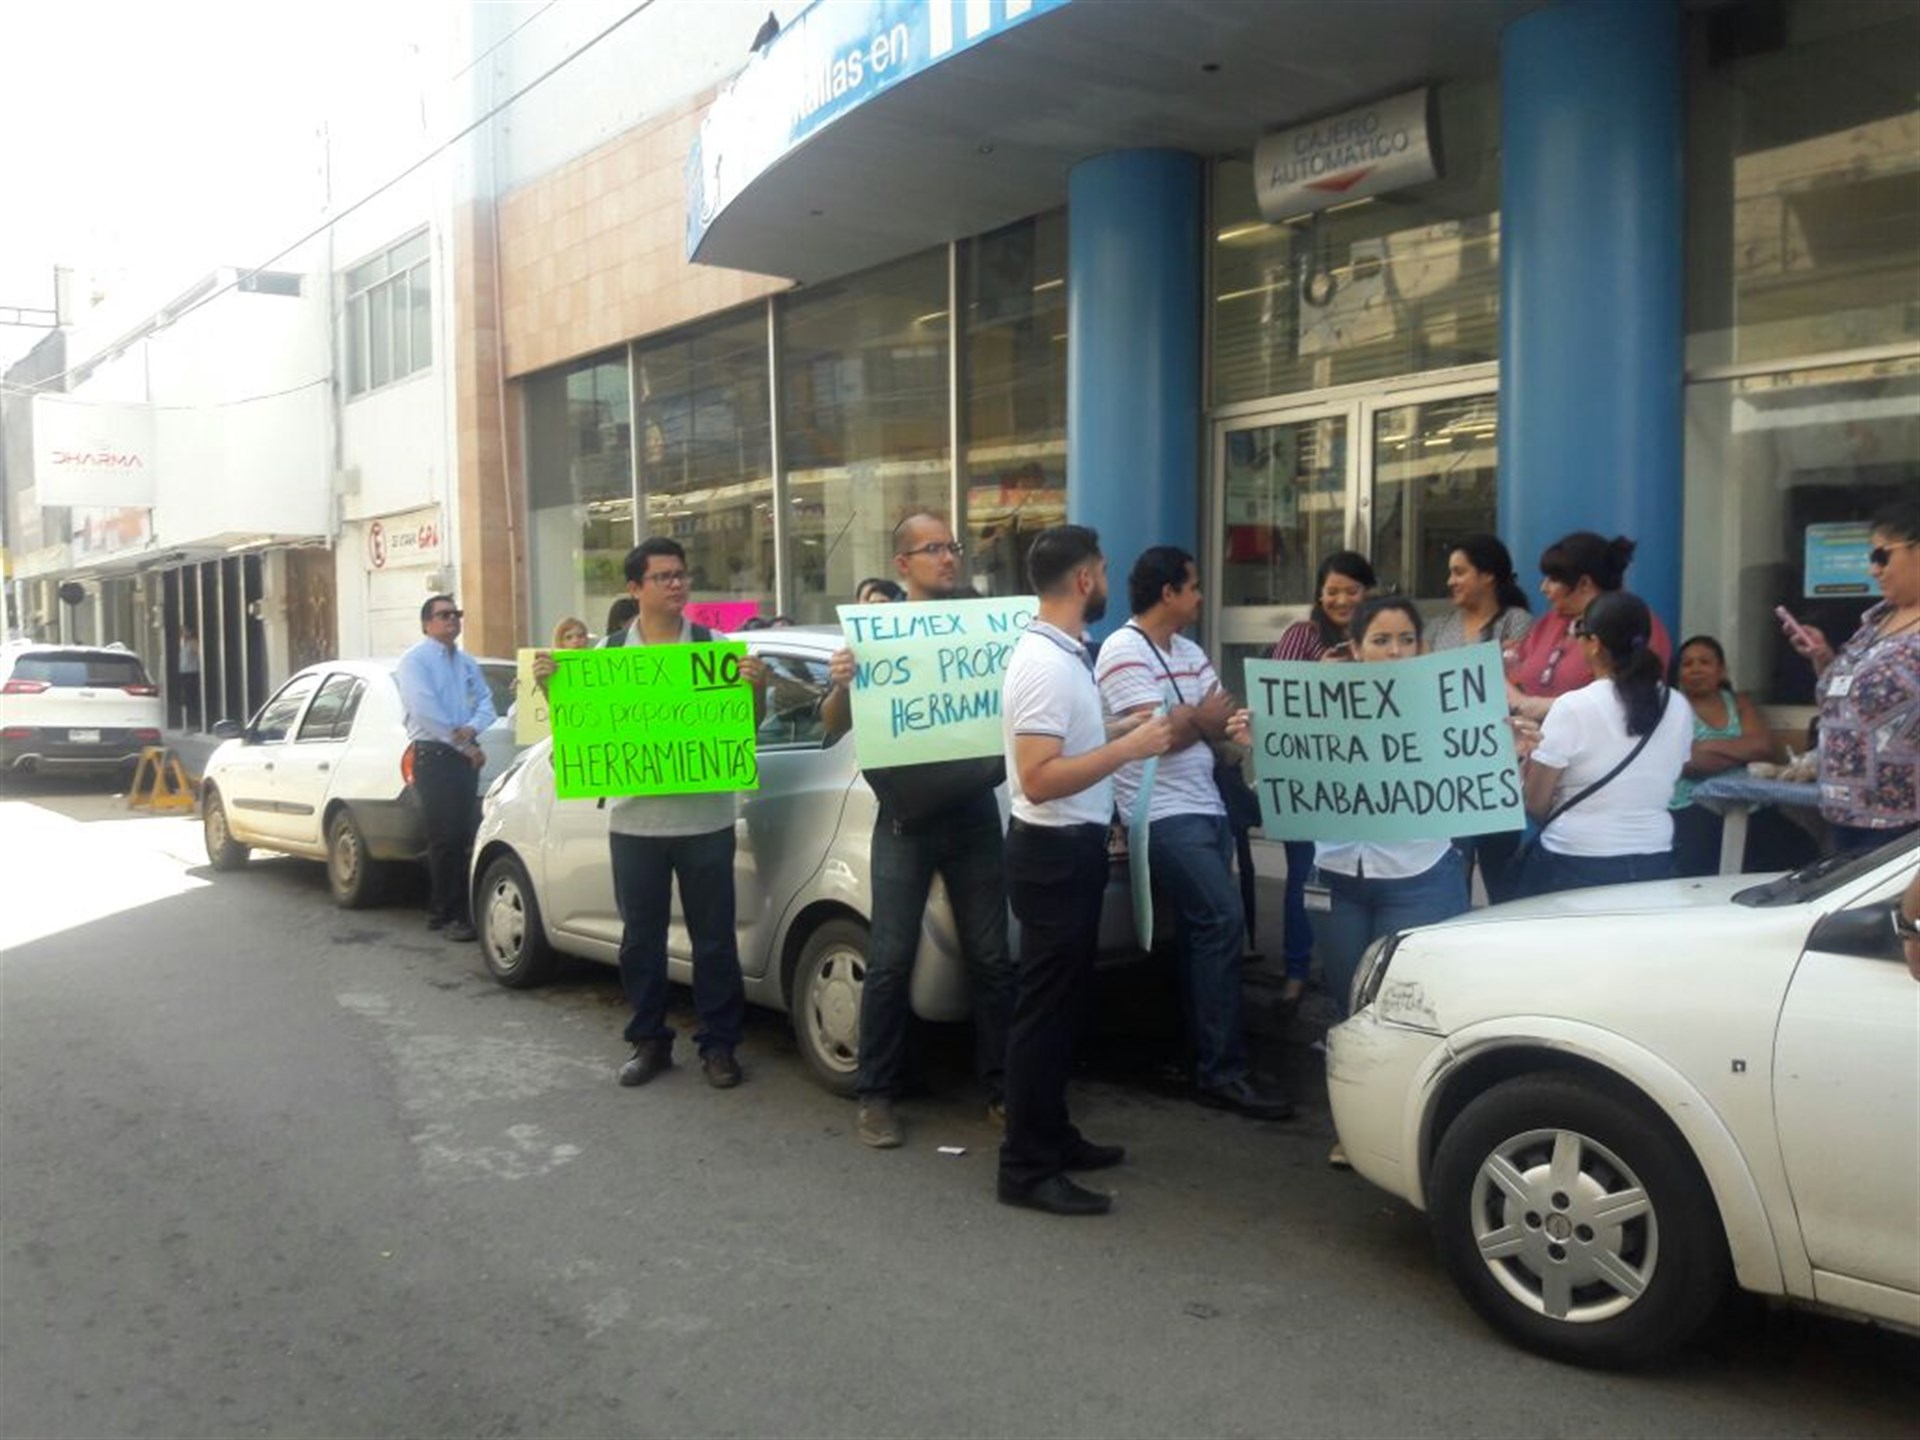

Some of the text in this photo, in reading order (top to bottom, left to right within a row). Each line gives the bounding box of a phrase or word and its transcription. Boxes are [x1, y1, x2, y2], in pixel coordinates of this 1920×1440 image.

[870, 23, 909, 73] en
[1294, 112, 1379, 155] CAJERO
[847, 610, 1032, 642] TELMEX NO
[557, 650, 741, 688] TELMEX NO
[855, 640, 1017, 689] NOS PROPO
[892, 690, 1002, 738] HERRAMI
[1259, 665, 1486, 719] TELMEX EN
[554, 702, 600, 727] nos
[610, 702, 749, 732] proporciona
[561, 738, 758, 787] HERRAMIENTAS
[1265, 724, 1498, 763] CONTRA DE SUS
[1263, 769, 1519, 816] TRABAJADORES
